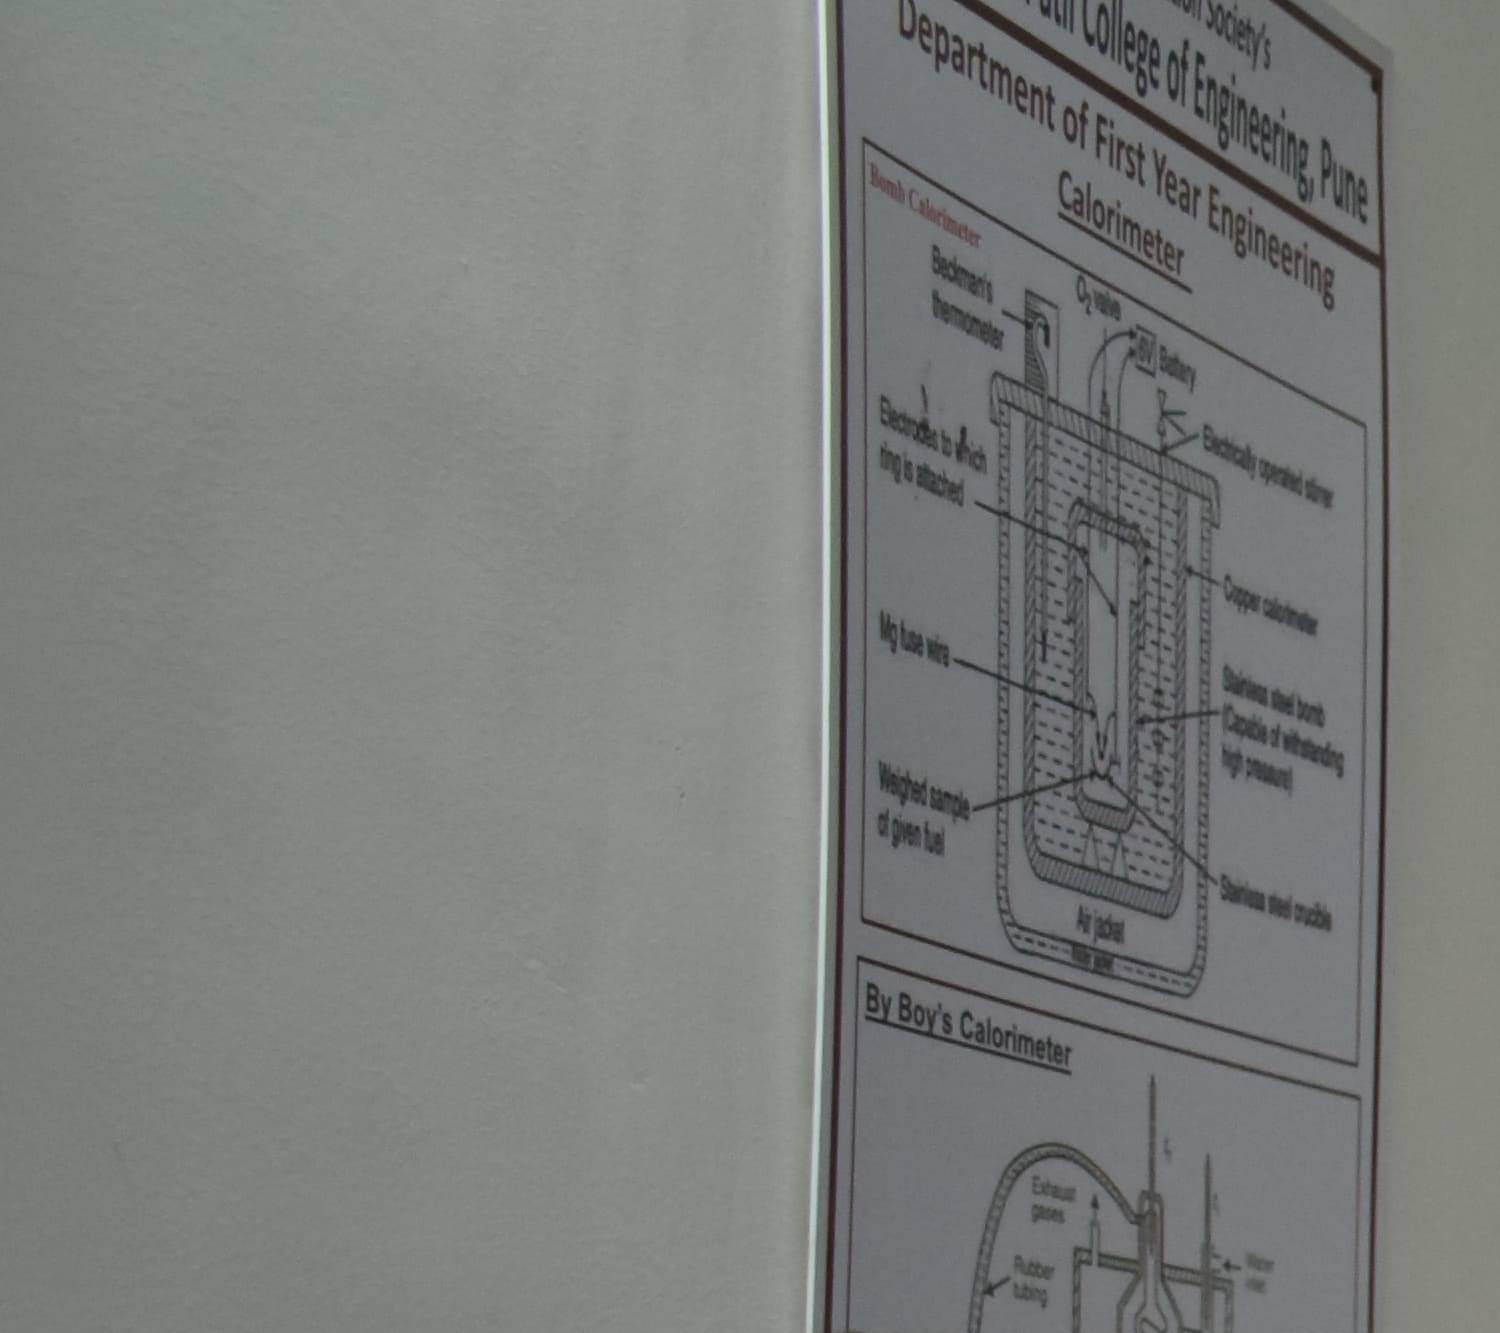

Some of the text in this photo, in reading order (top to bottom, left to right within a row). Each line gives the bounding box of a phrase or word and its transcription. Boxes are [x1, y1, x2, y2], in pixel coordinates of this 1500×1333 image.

[1206, 0, 1271, 70] Society's
[898, 1, 1336, 311] Department of First Year Engineering
[1026, 0, 1368, 224] atil College of Engineering, Pune
[908, 183, 982, 249] Calorimeter
[1058, 170, 1186, 276] Calorimeter
[865, 984, 1073, 1068] By Boy's Calorimeter
